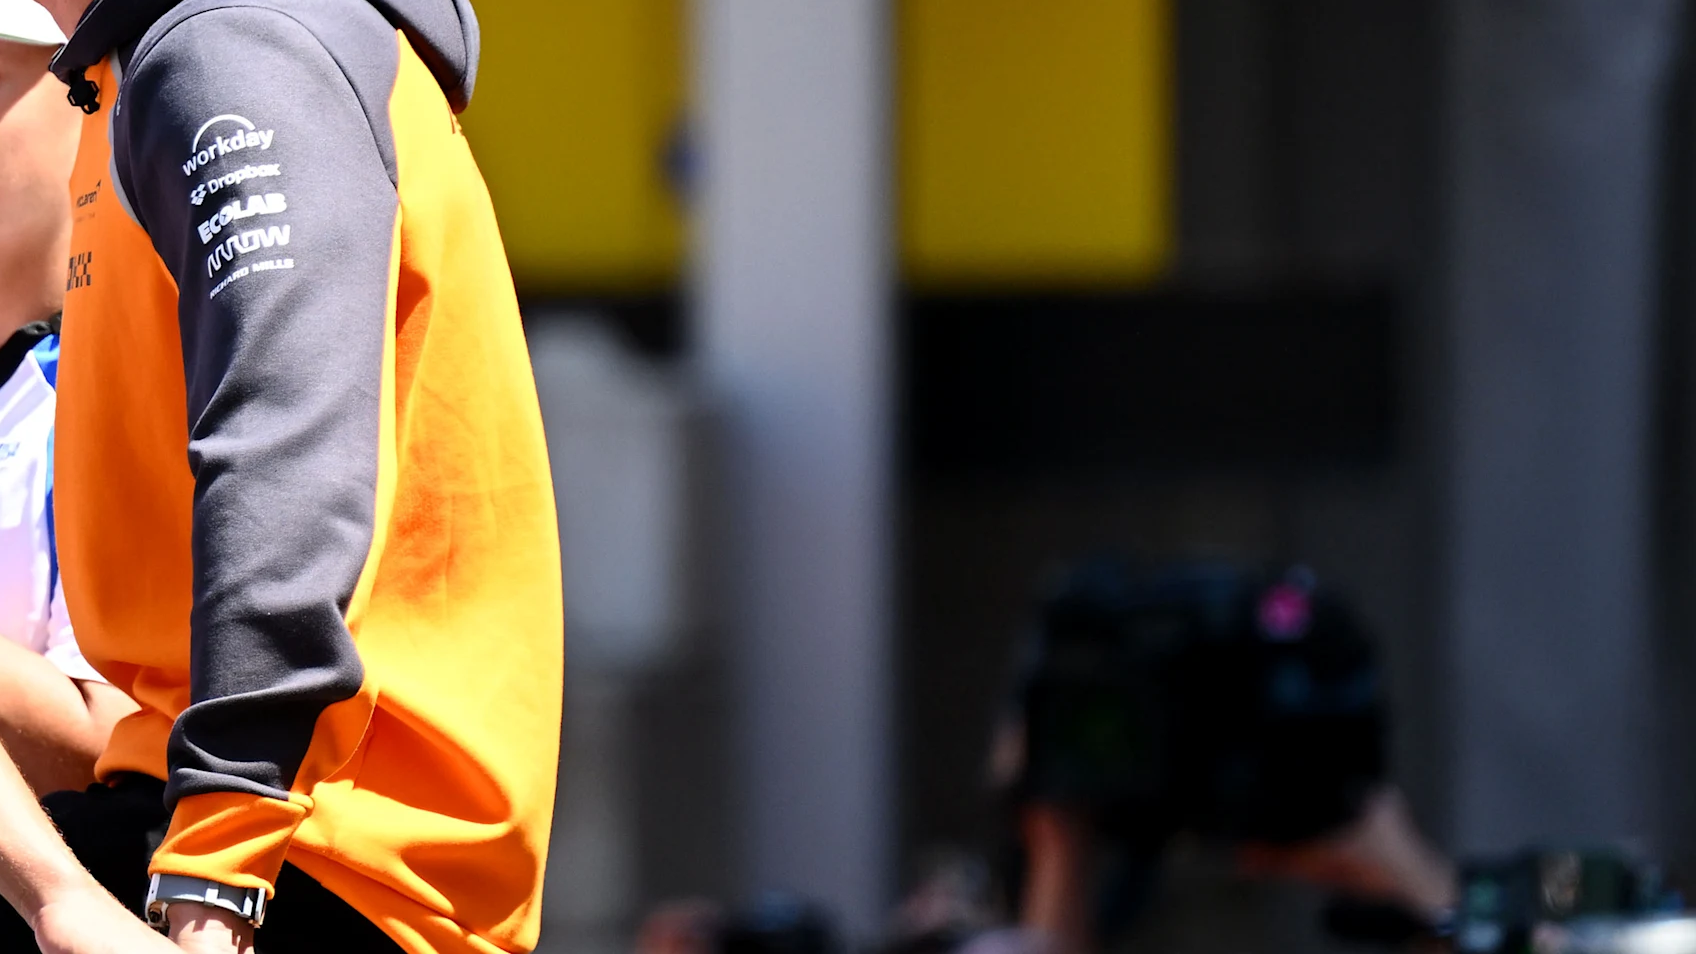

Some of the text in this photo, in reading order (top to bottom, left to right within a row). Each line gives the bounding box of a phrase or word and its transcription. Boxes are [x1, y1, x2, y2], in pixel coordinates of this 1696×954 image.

[182, 128, 275, 177] workday
[207, 163, 282, 195] Dropbox
[197, 193, 288, 245] ECOLAB
[209, 258, 295, 300] RICHARD MILLE
